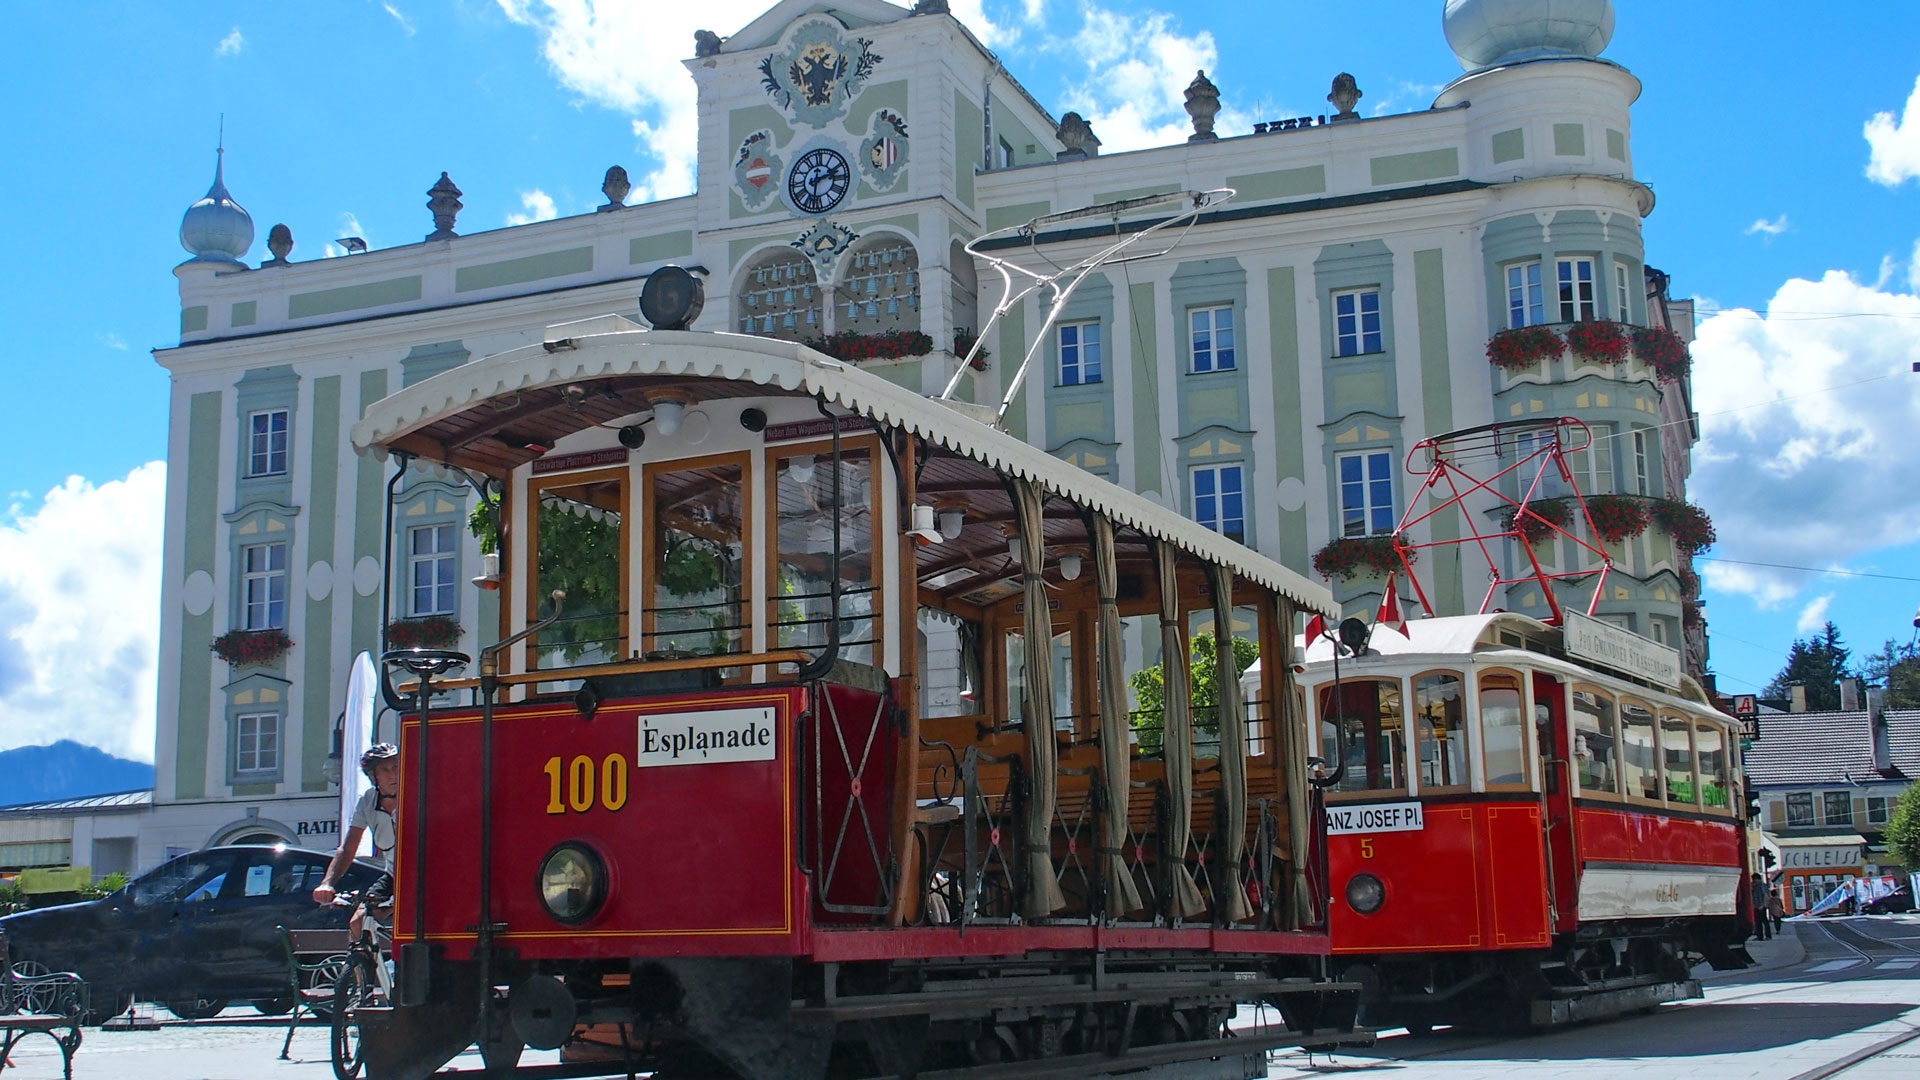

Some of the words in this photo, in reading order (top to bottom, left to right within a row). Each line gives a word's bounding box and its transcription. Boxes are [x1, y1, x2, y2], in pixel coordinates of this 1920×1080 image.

[642, 722, 770, 758] Esplanade
[544, 753, 628, 814] 100
[1356, 808, 1400, 829] JOSEF
[1360, 838, 1374, 859] 5
[1782, 851, 1860, 867] SCHLEISS
